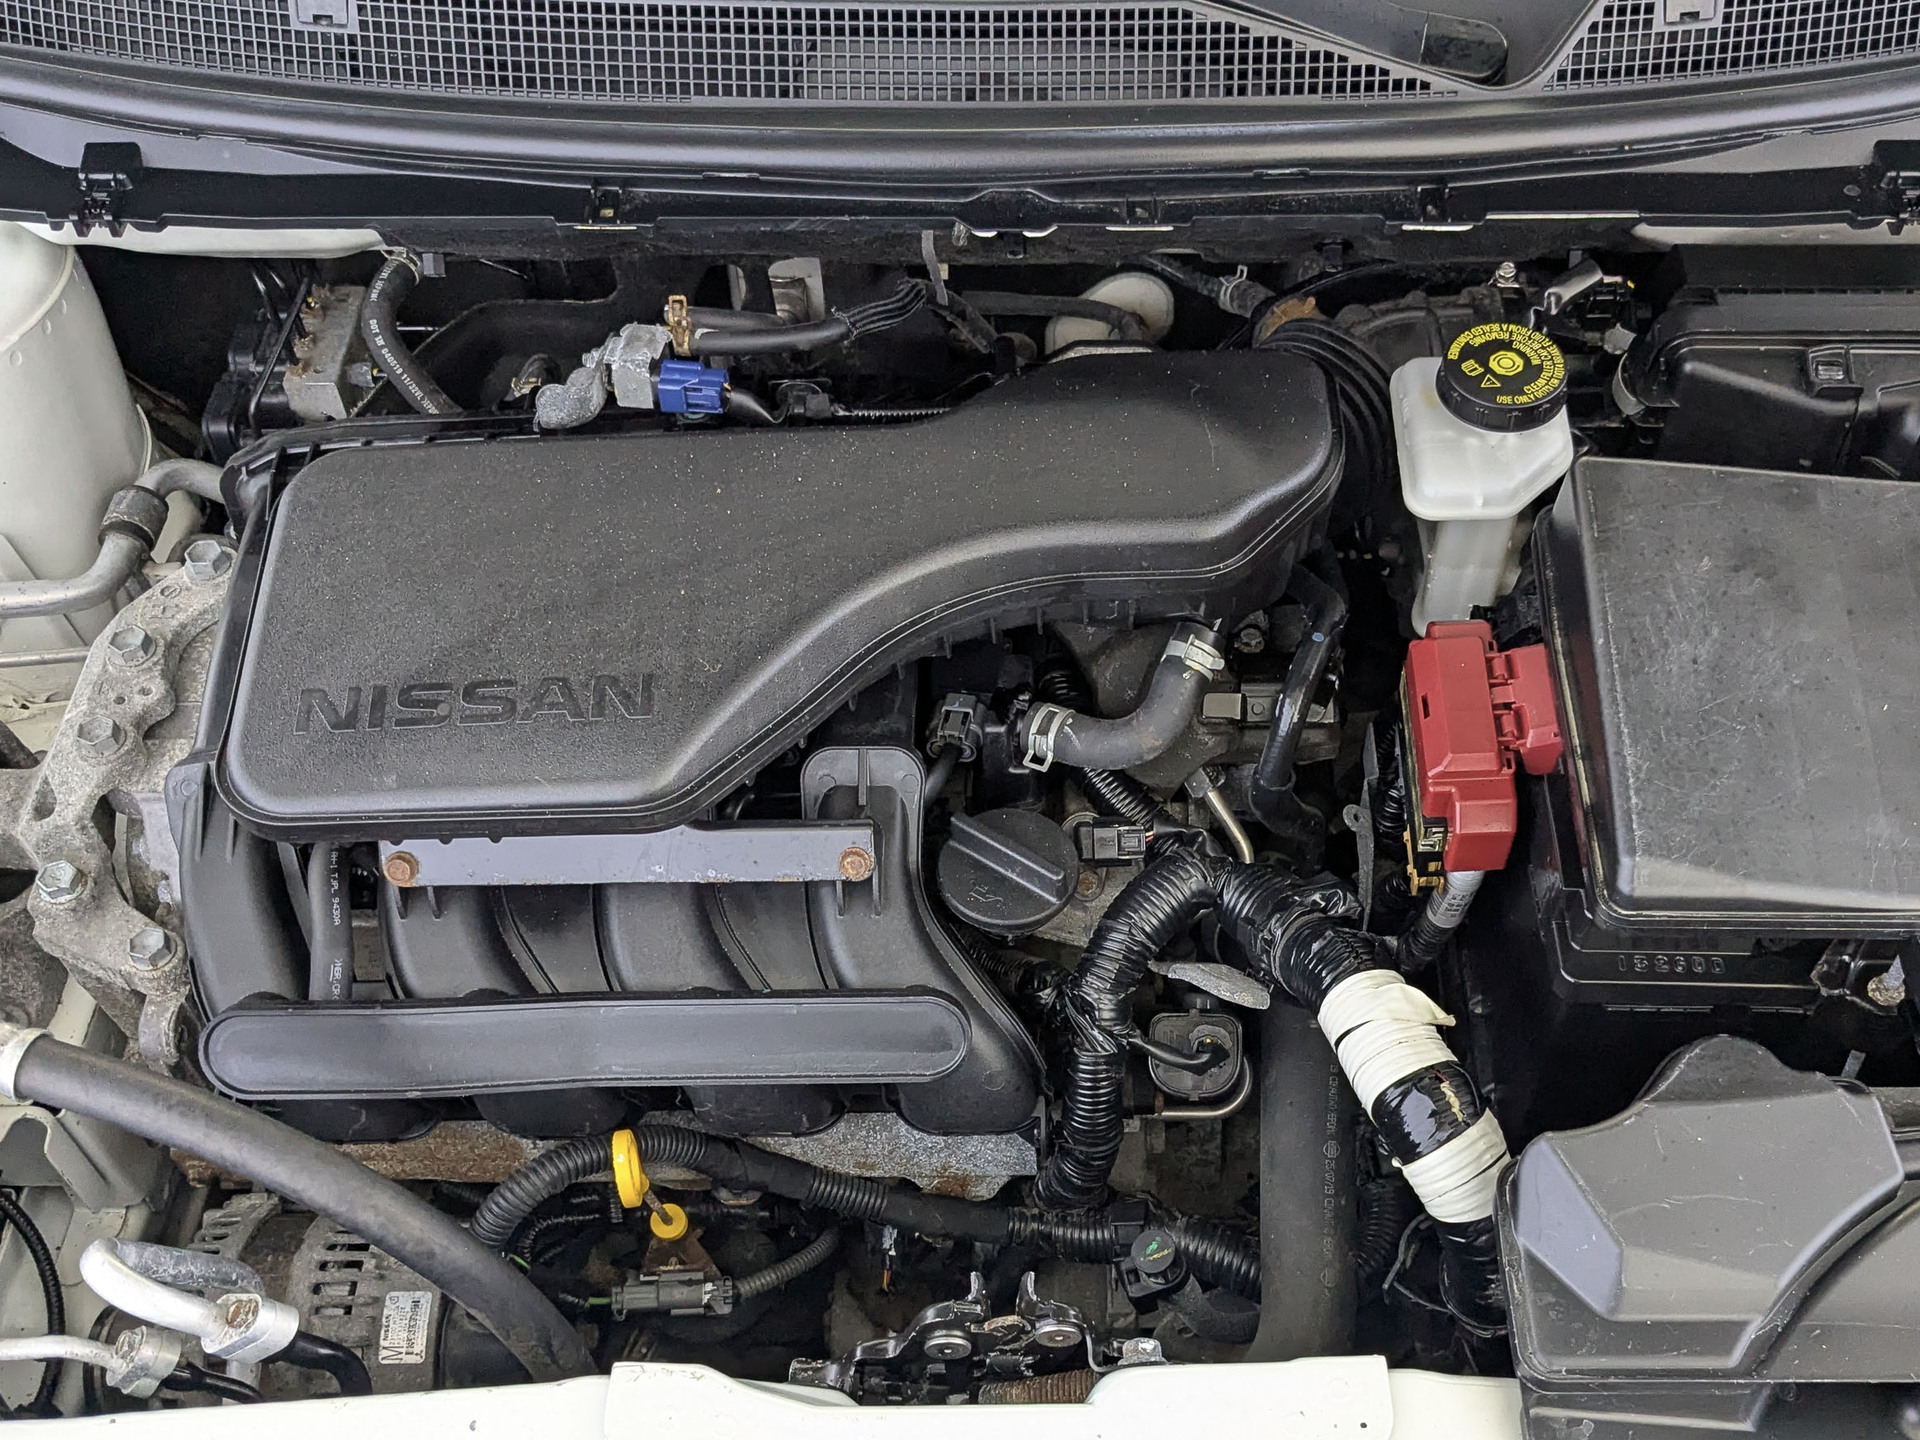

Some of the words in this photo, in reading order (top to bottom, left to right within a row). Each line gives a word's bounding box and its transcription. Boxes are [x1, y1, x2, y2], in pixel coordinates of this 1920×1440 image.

[1470, 323, 1501, 335] SEALED
[1501, 323, 1508, 332] A
[1508, 323, 1532, 336] FROM
[1468, 331, 1510, 347] REMOVING
[1511, 331, 1542, 353] BEFORE
[1531, 331, 1554, 346] FLUID
[369, 319, 378, 336] DOT
[401, 374, 423, 402] 11/32VL
[1511, 341, 1542, 366] WARNING
[1537, 347, 1553, 362] CAP
[1546, 346, 1565, 365] BRAKE
[1541, 360, 1554, 380] FILLER
[1554, 364, 1565, 380] DOT4
[1523, 377, 1547, 394] CLEAN
[1549, 378, 1560, 389] OR
[1496, 395, 1513, 404] USE
[1514, 395, 1535, 405] ONLY
[1534, 385, 1554, 400] DOT3
[293, 673, 656, 735] NISSAN
[331, 897, 341, 926] 9430A
[1324, 1160, 1336, 1195] 25/07/19
[382, 1313, 392, 1342] NISSAN
